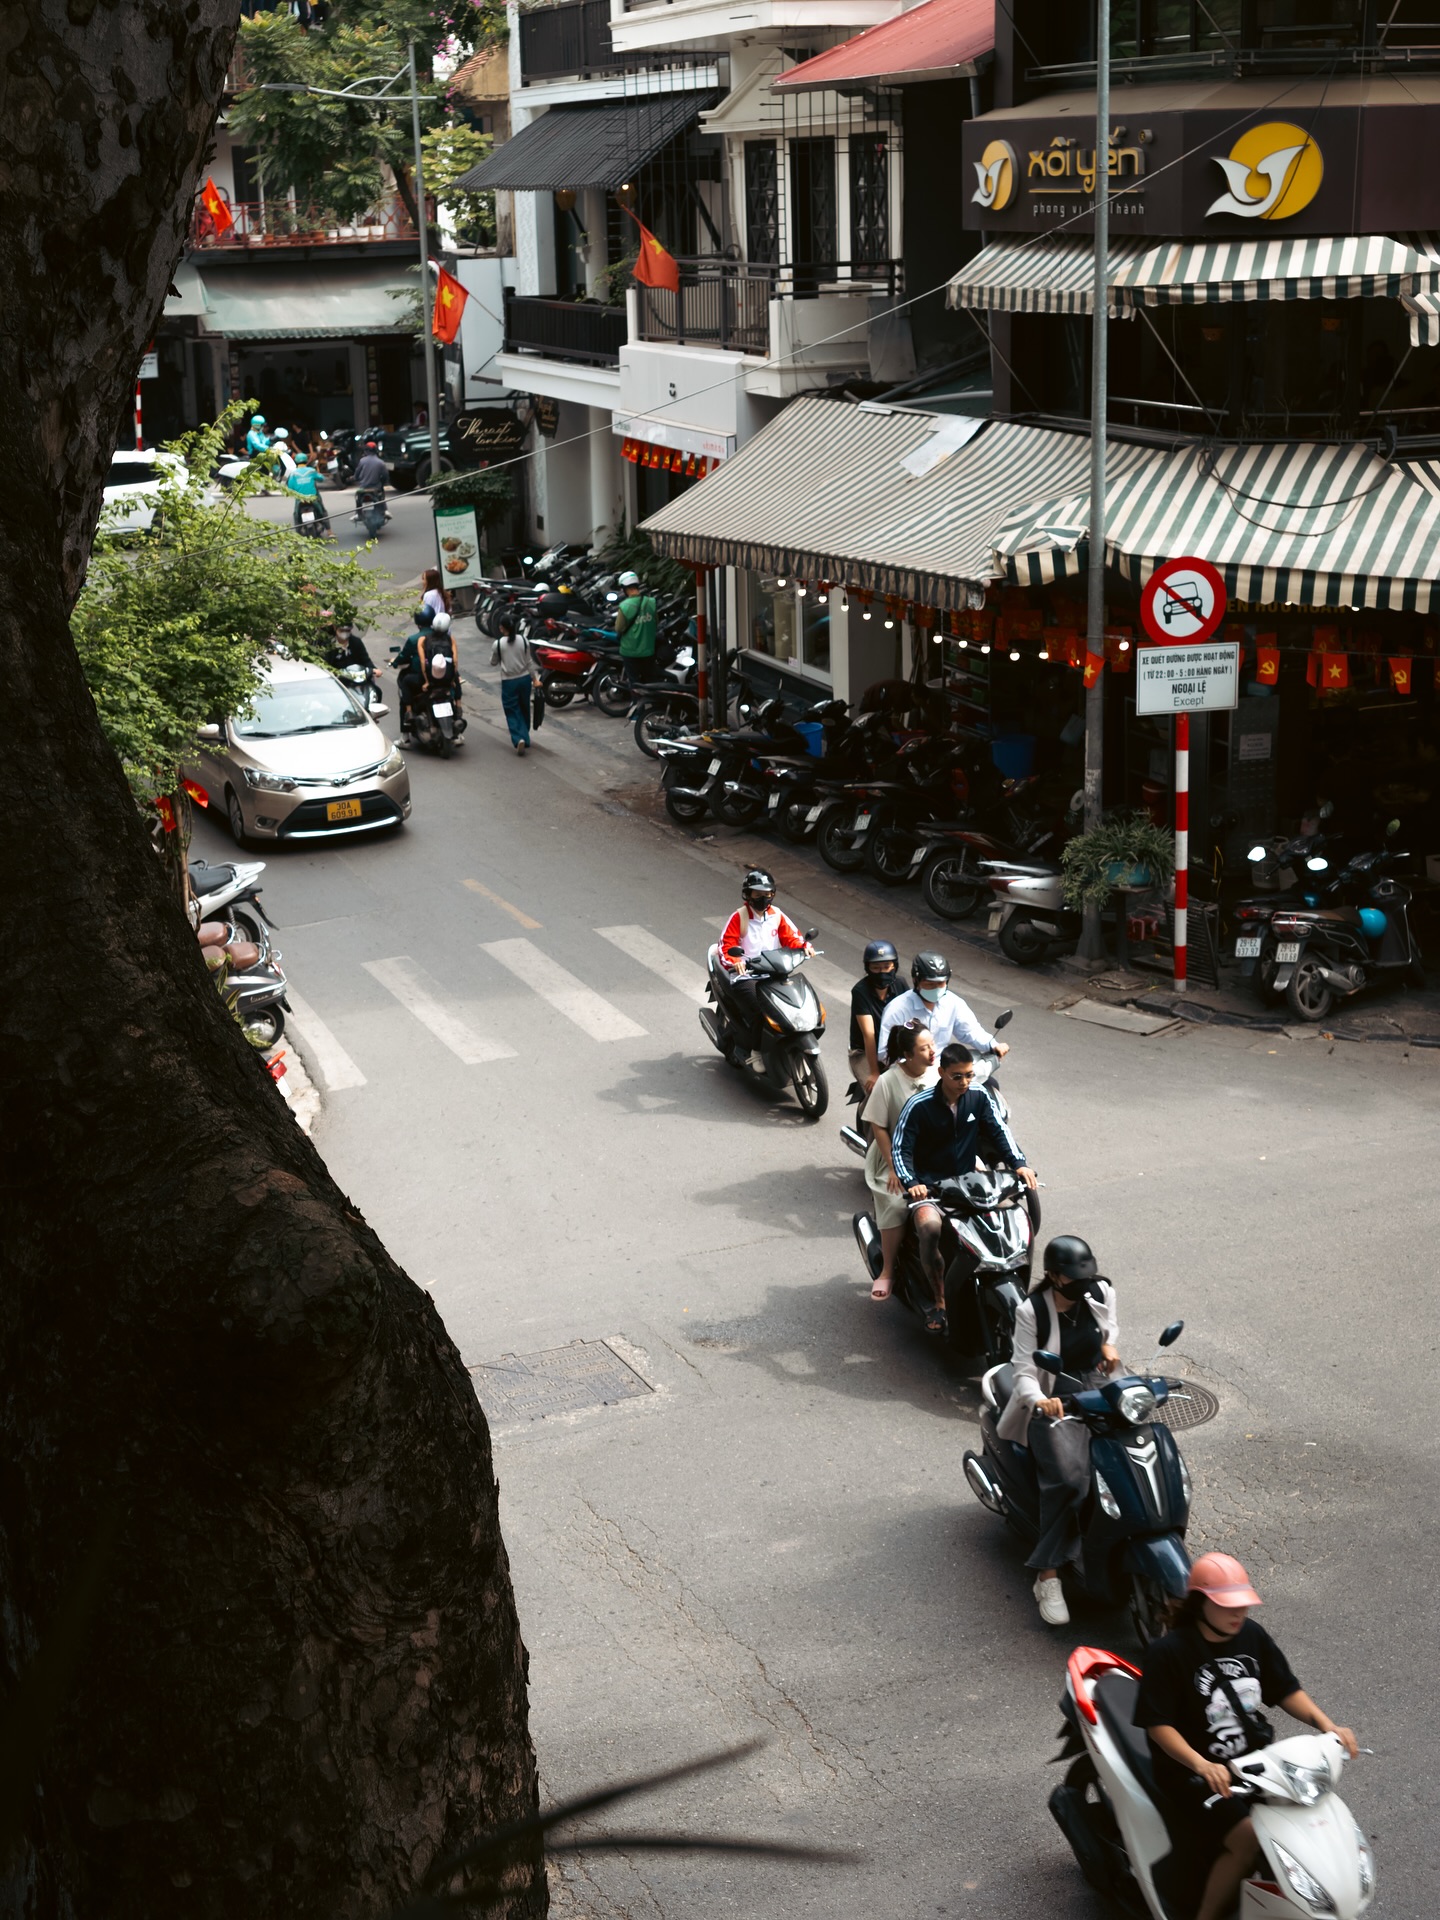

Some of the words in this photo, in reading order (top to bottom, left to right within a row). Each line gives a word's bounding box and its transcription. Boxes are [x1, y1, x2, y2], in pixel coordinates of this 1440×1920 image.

[1033, 203, 1065, 217] phong
[1110, 201, 1145, 214] Thành
[1142, 656, 1149, 665] XE
[1151, 653, 1165, 665] QUÉT
[1203, 651, 1218, 663] HOẠT
[1172, 683, 1195, 695] NGOẠI
[1197, 680, 1206, 694] LỆ
[1173, 696, 1204, 707] Except
[336, 801, 352, 810] 30A
